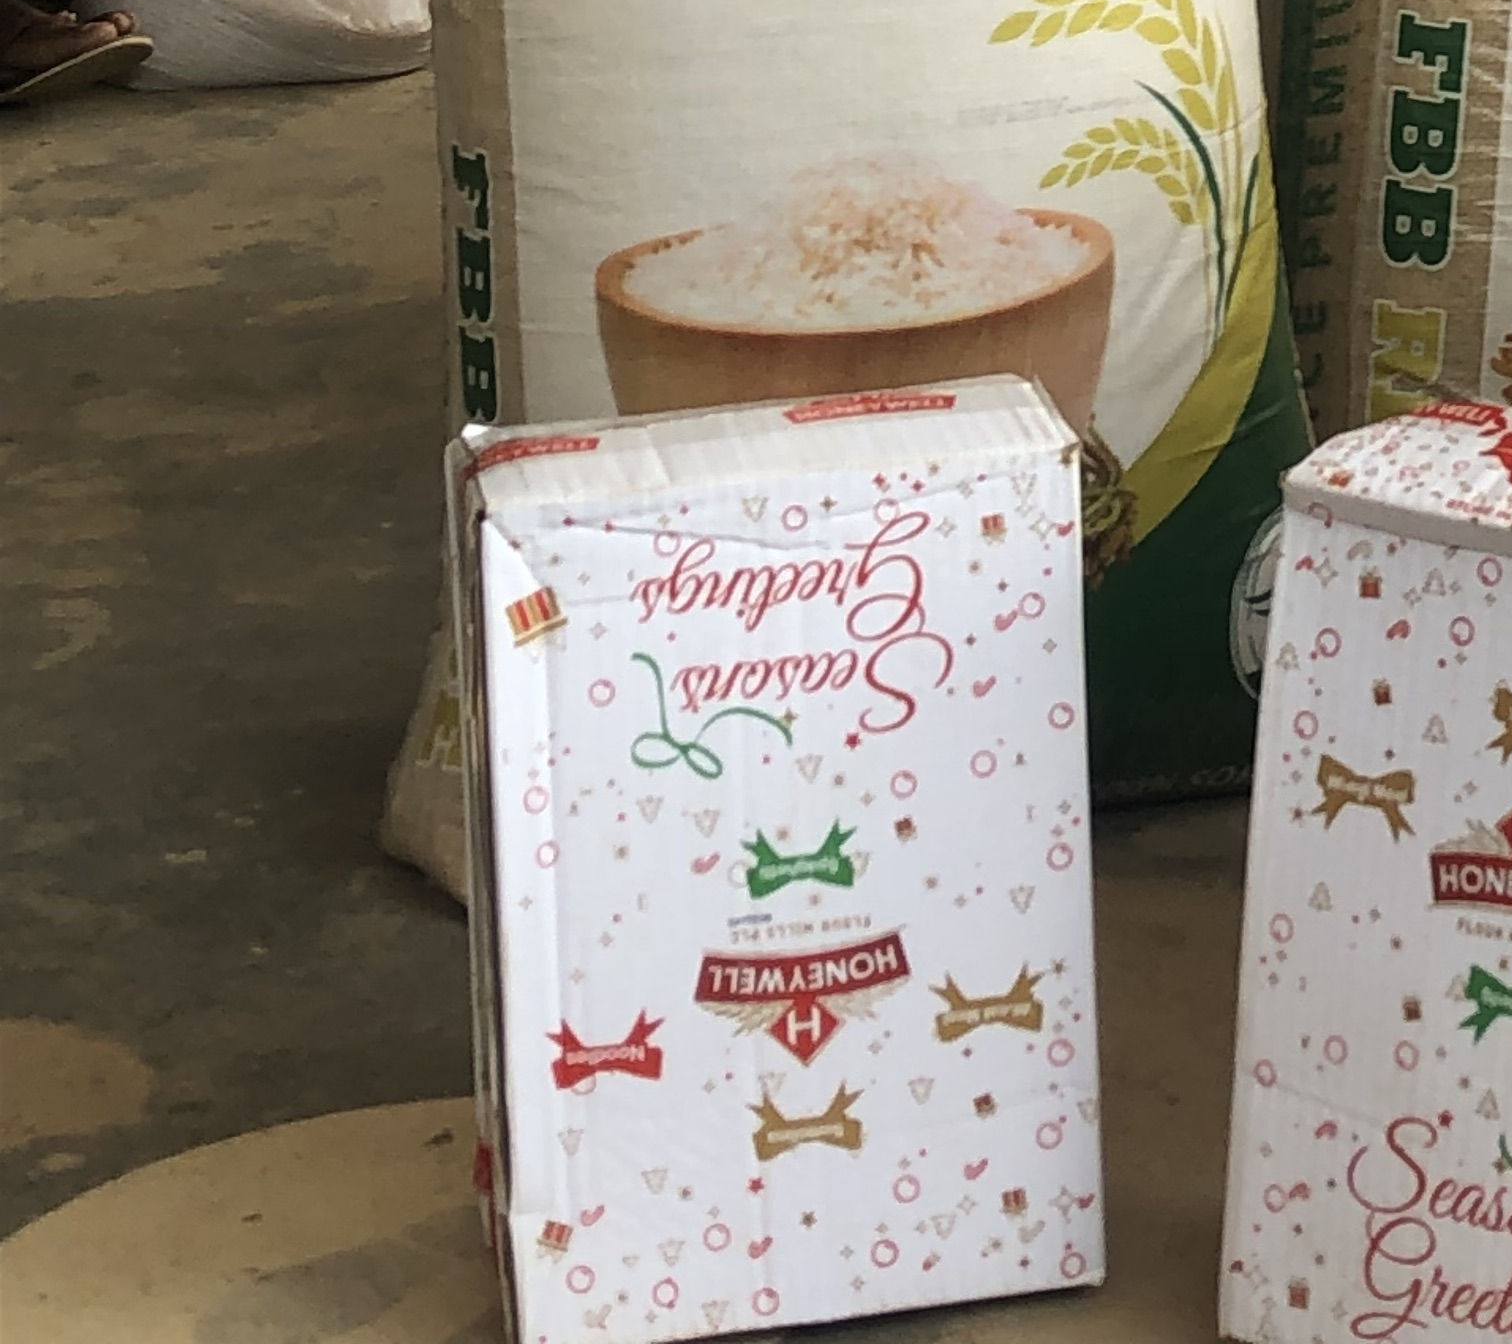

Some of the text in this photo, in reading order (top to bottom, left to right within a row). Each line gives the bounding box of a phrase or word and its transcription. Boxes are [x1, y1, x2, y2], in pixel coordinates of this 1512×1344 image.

[452, 143, 499, 422] FBB
[1367, 10, 1472, 424] FBB RI
[632, 510, 930, 643] Greetings
[706, 940, 899, 998] HONEYWELL
[784, 1010, 822, 1044] H
